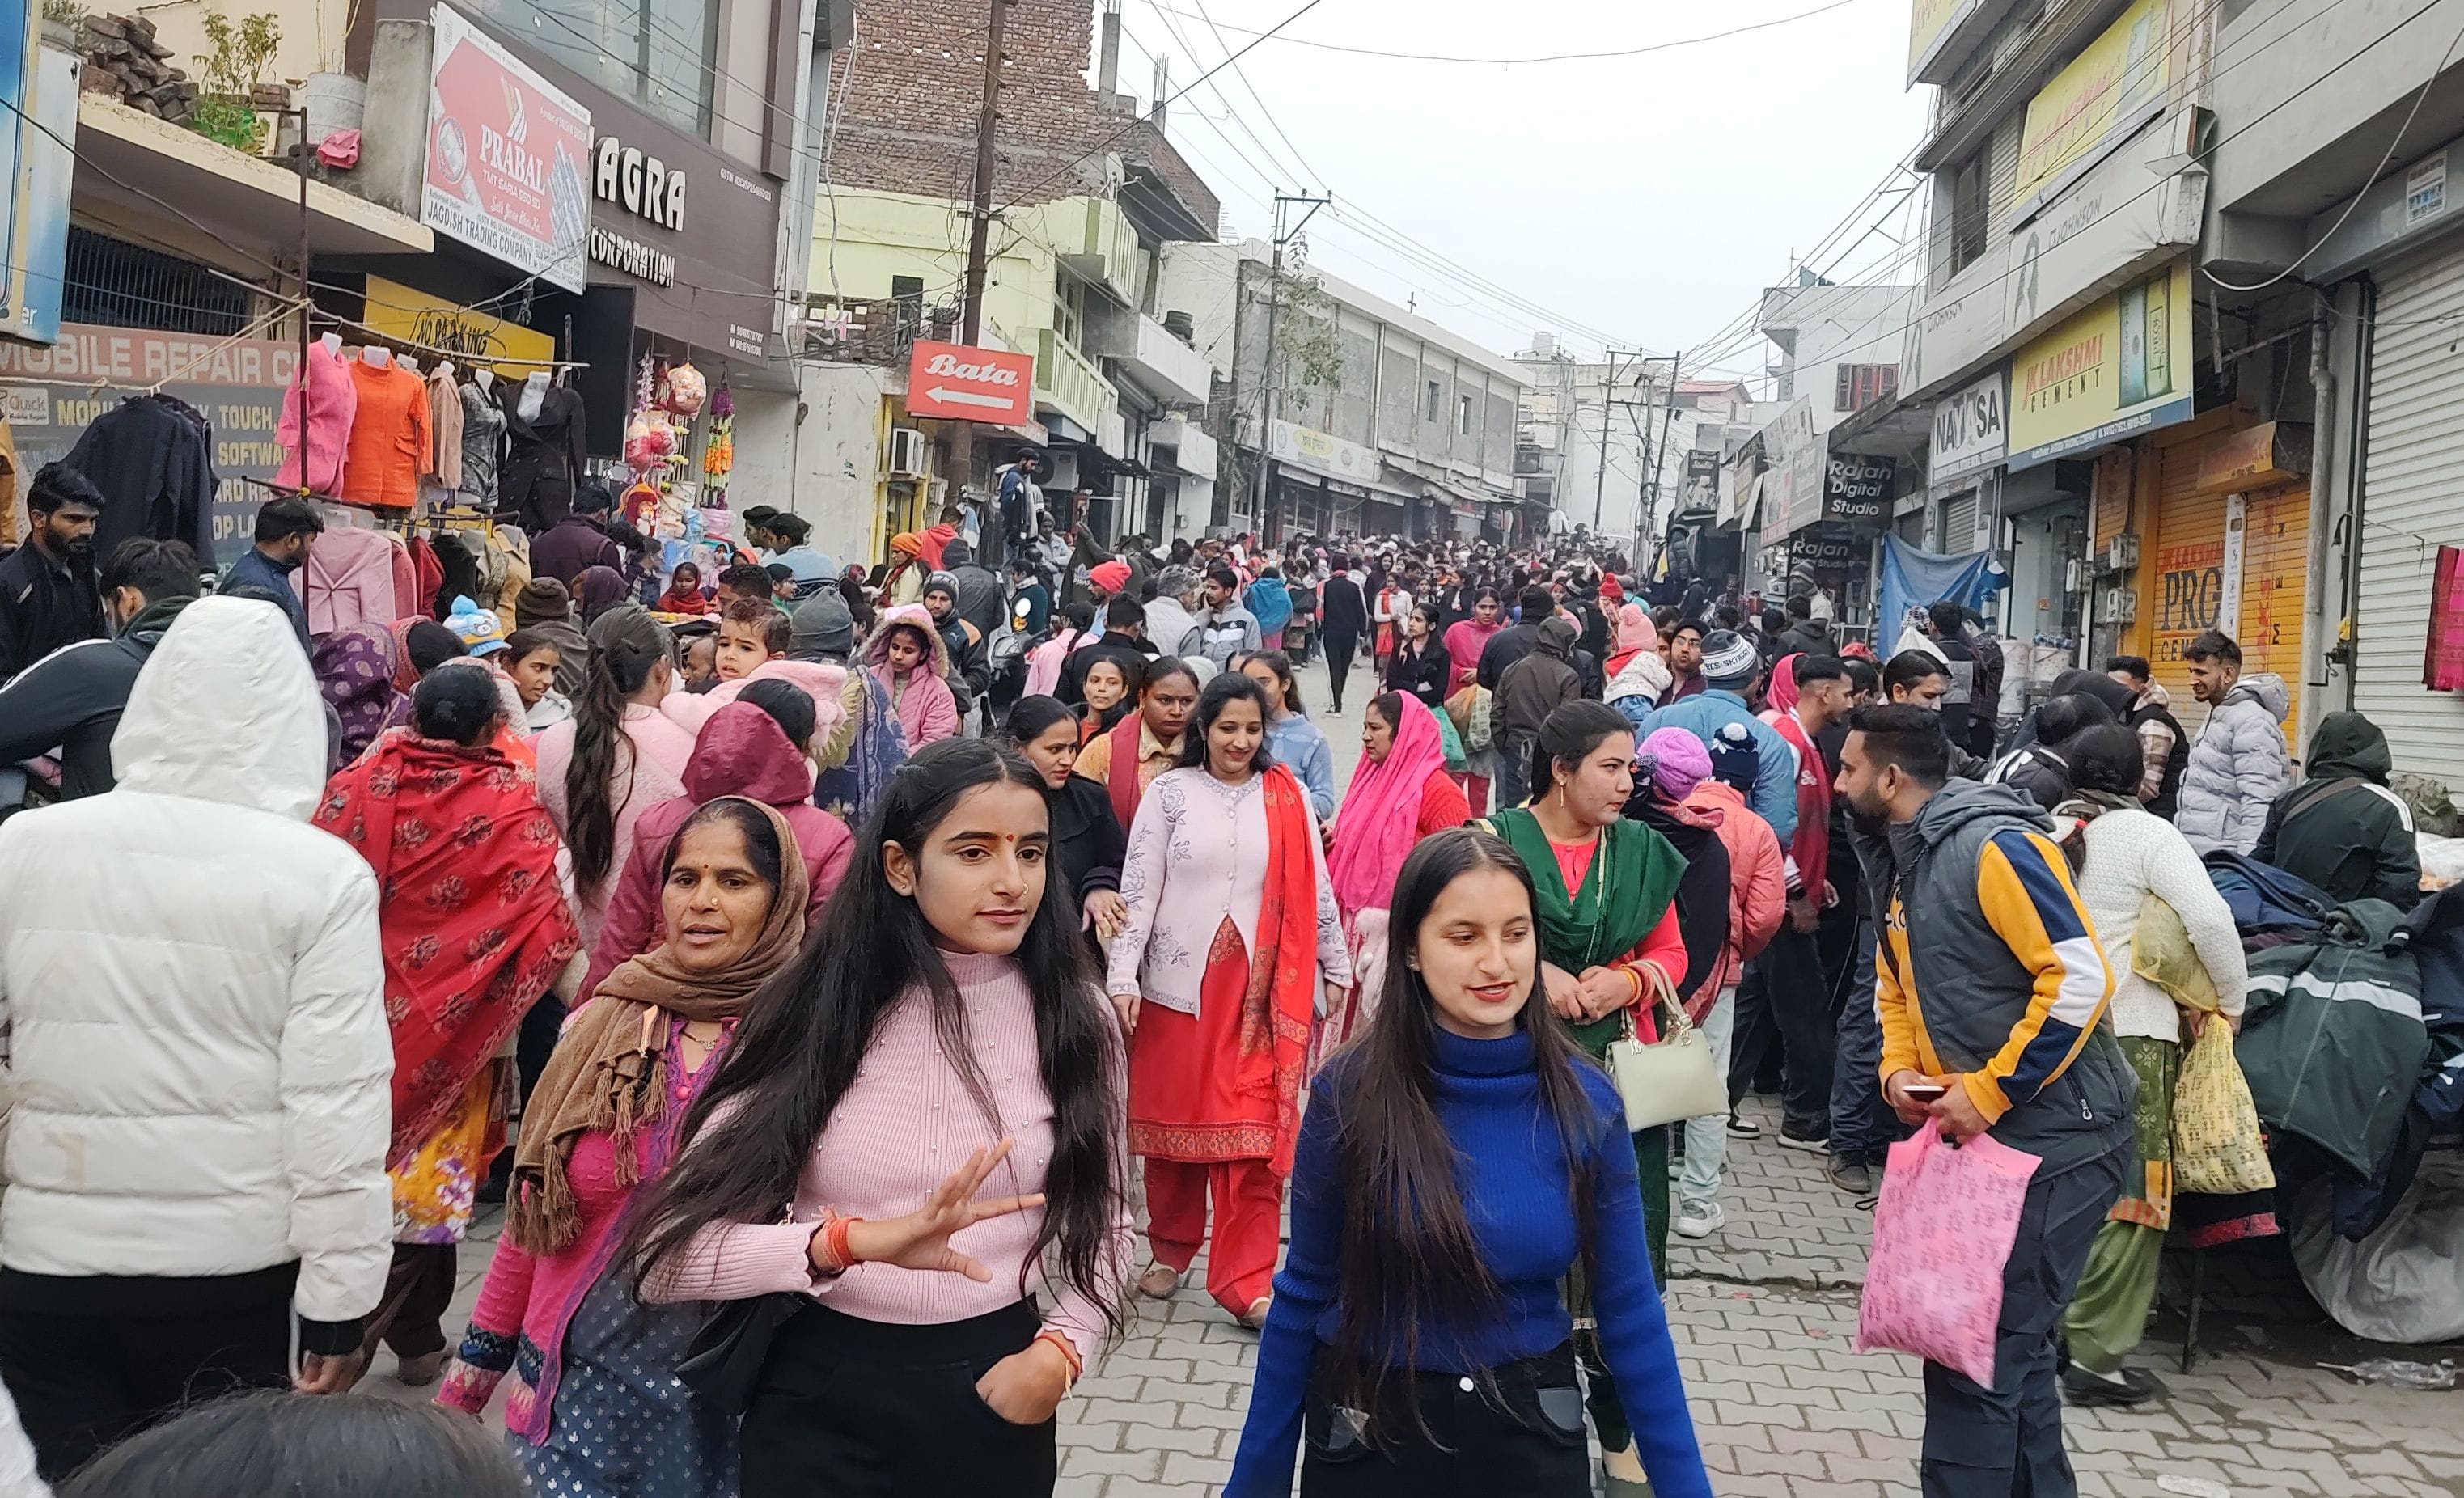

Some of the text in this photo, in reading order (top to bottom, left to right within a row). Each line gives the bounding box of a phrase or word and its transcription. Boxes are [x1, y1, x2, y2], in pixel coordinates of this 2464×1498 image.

[479, 124, 545, 196] PRABAL
[483, 169, 497, 189] TMT
[595, 136, 686, 231] AGRA
[427, 200, 463, 234] JAGDISH
[465, 218, 497, 250] TRADING
[499, 235, 533, 266] COMPANY
[591, 226, 675, 289] CORPORATION
[417, 318, 433, 348] NO
[144, 339, 262, 383] REPAIR
[272, 349, 301, 387] C
[924, 353, 1019, 387] Bata
[2022, 364, 2038, 411] JK
[2040, 333, 2103, 387] LAKSHMI
[9, 396, 45, 412] Quick
[2031, 368, 2100, 413] CEMENT
[1829, 460, 1893, 480] Rajan
[1831, 480, 1883, 498] Digital
[1831, 499, 1879, 517] Studio
[1792, 540, 1848, 558] Rajan
